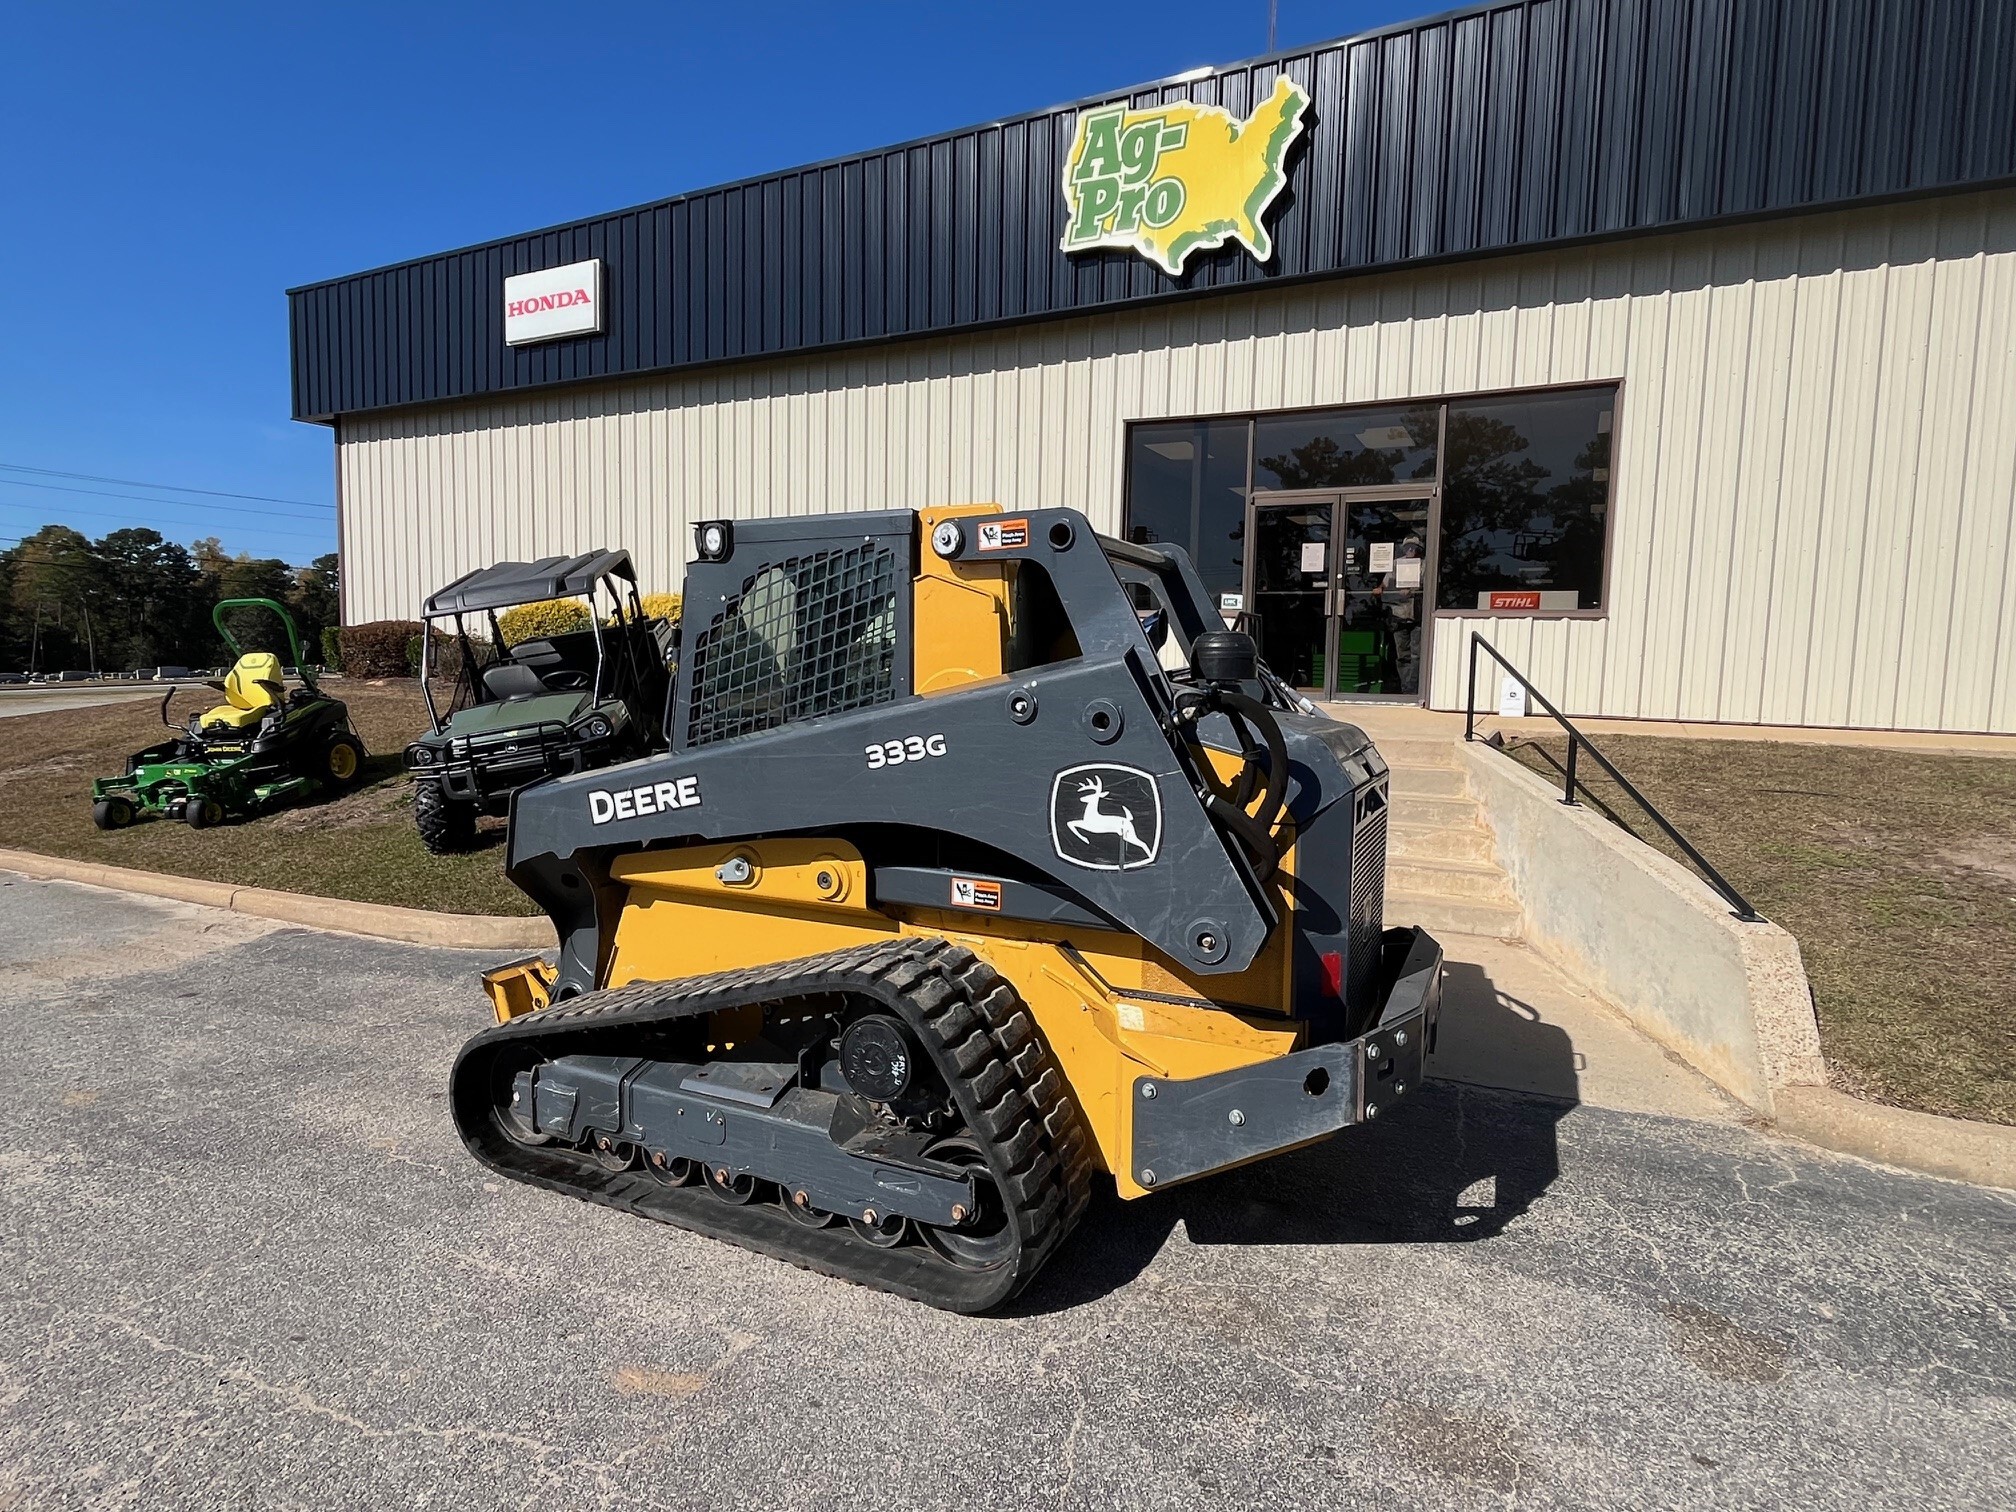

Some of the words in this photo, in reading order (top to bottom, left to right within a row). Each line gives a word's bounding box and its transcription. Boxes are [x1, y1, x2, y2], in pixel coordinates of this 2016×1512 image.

[1073, 106, 1188, 185] Ag-
[1070, 175, 1186, 244] Pro
[508, 288, 591, 317] HONDA
[1494, 598, 1534, 607] STIHL
[864, 733, 947, 770] 333G
[588, 776, 701, 825] DEERE
